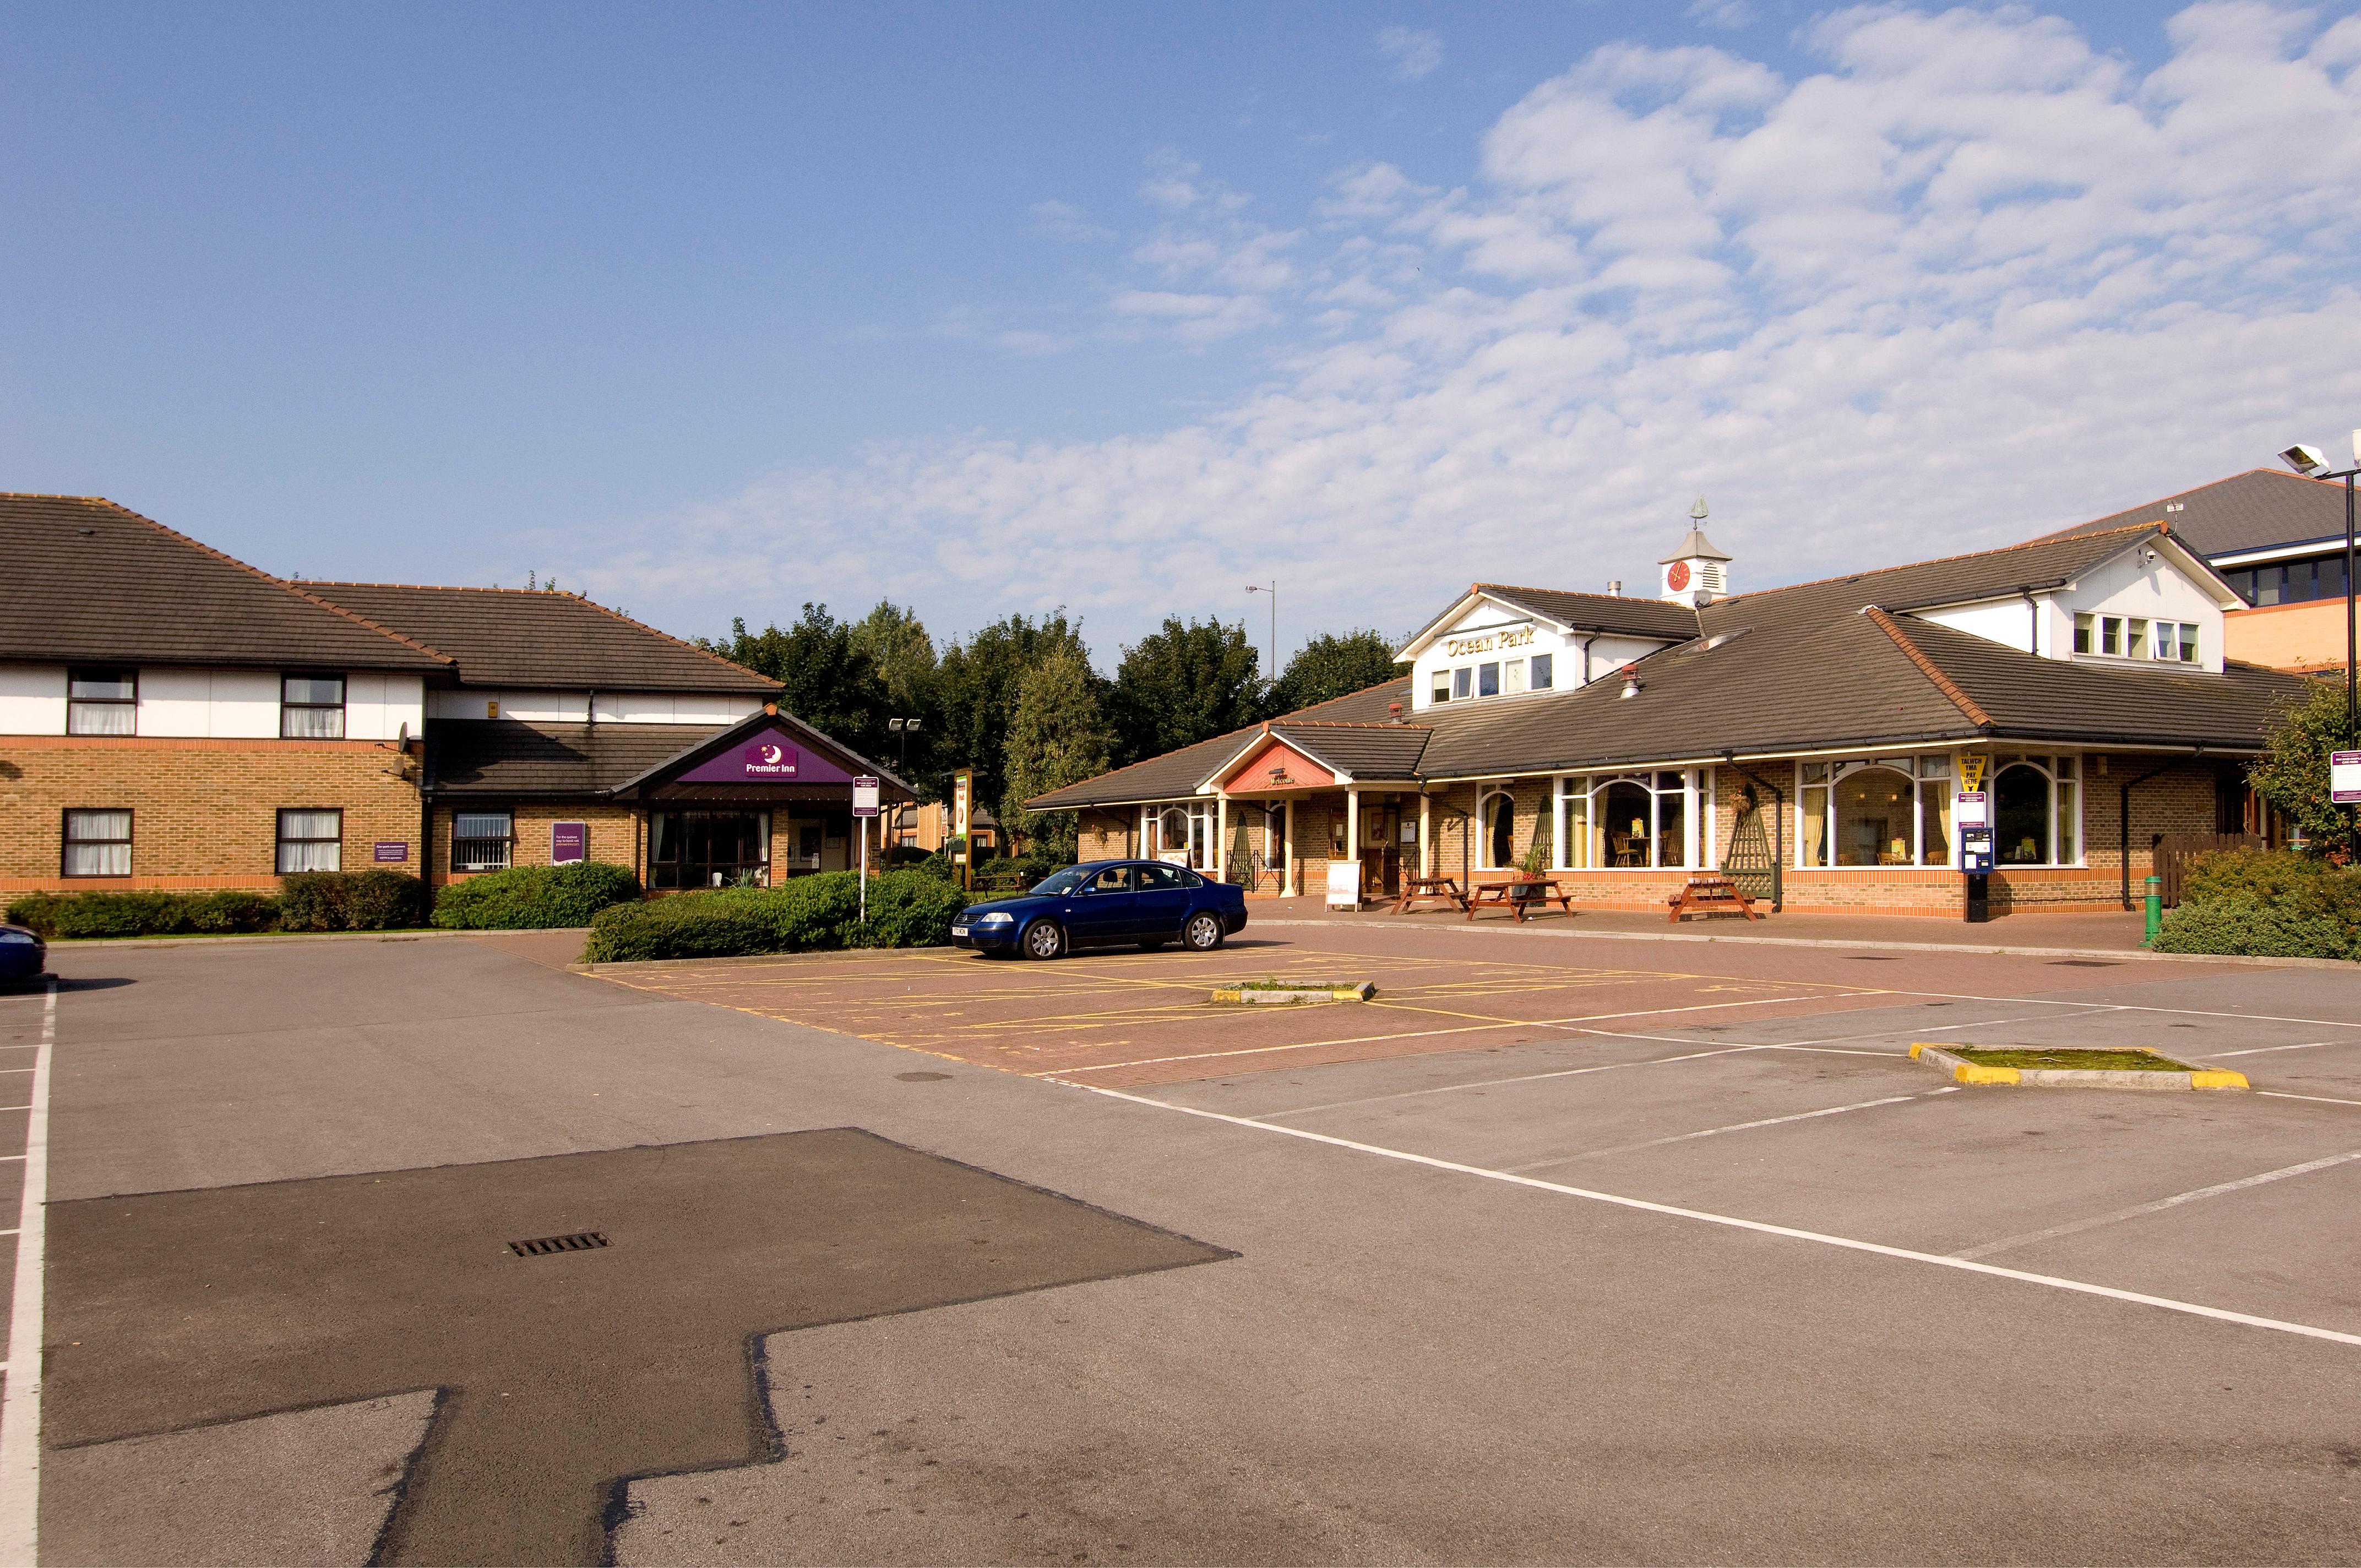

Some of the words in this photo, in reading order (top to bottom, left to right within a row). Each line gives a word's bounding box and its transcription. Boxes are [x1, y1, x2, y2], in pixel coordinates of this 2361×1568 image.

[1447, 640, 1493, 657] Ocean
[1498, 625, 1534, 649] Park
[746, 764, 780, 772] Premier
[781, 764, 795, 772] Inn
[1271, 777, 1294, 785] Welcome
